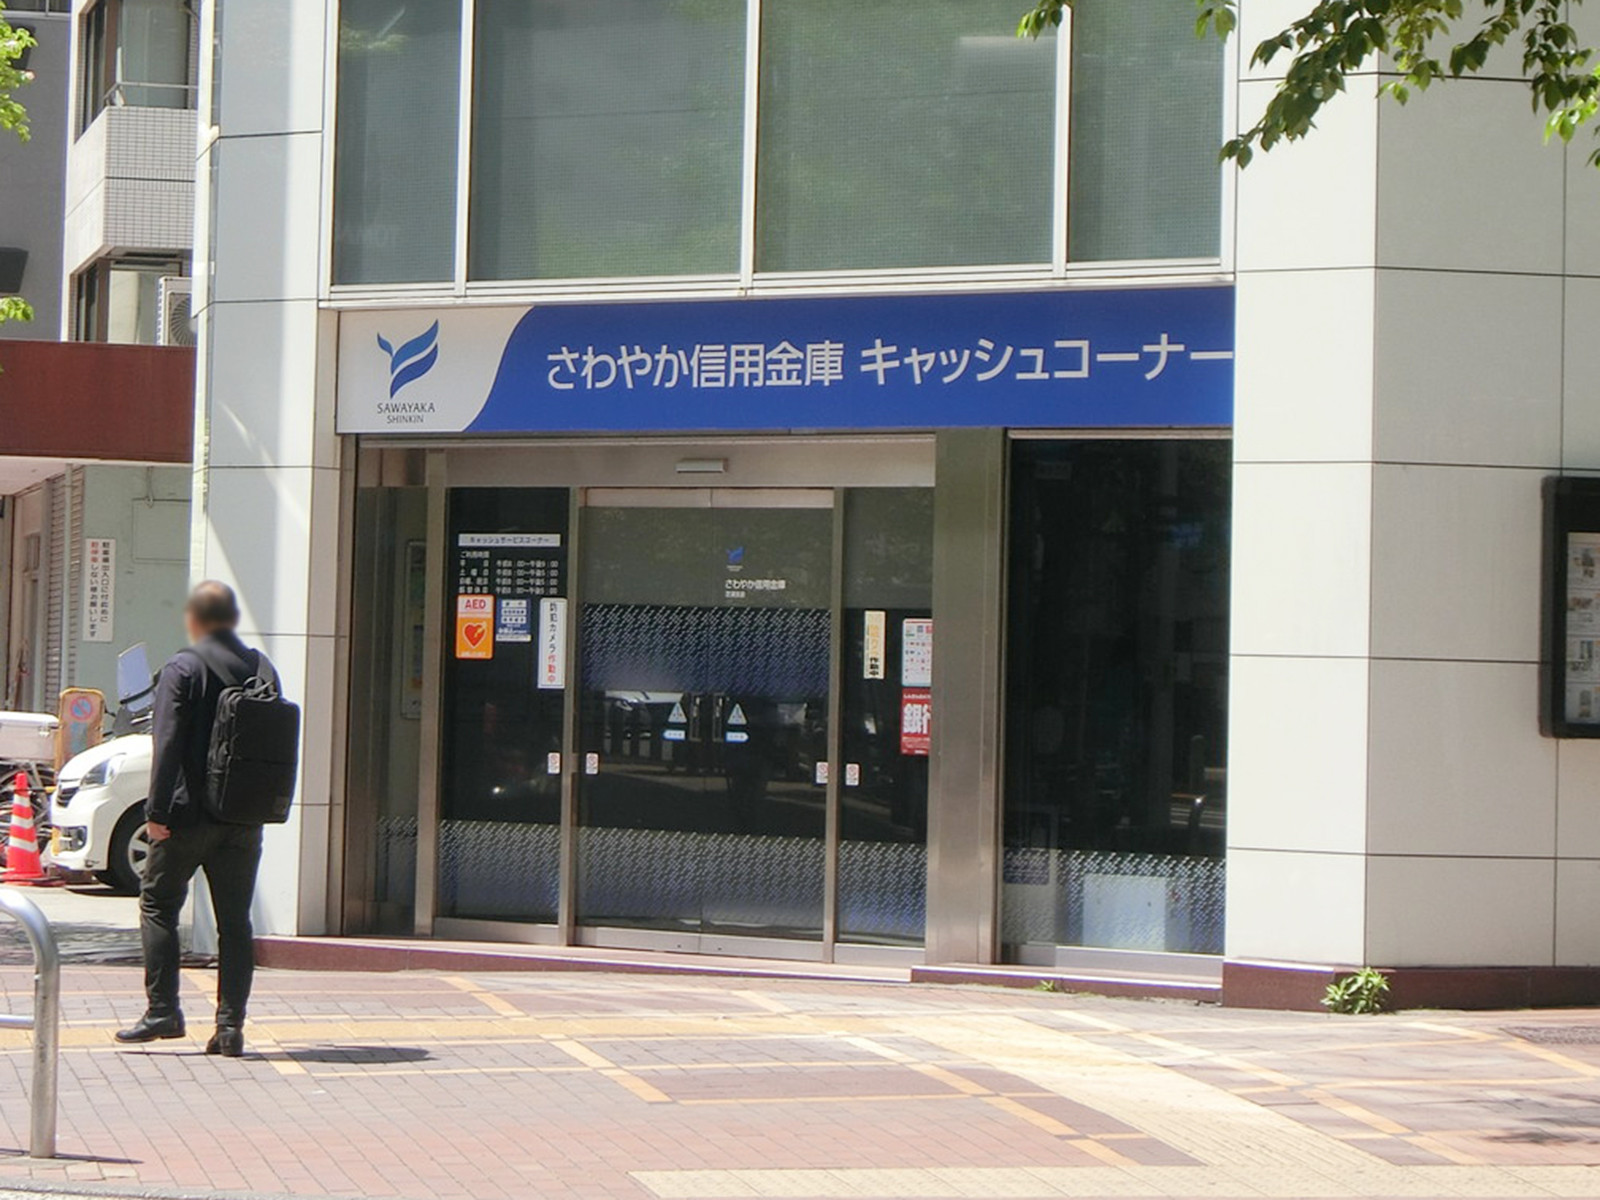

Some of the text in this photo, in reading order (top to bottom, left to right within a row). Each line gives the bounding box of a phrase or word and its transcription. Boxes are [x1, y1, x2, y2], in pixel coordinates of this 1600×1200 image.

[547, 333, 1233, 390] さわやか信用金庫 キャッシュコーナー
[377, 402, 436, 414] SAWAYAKA
[386, 414, 425, 424] SHINKIN
[464, 599, 487, 610] AED
